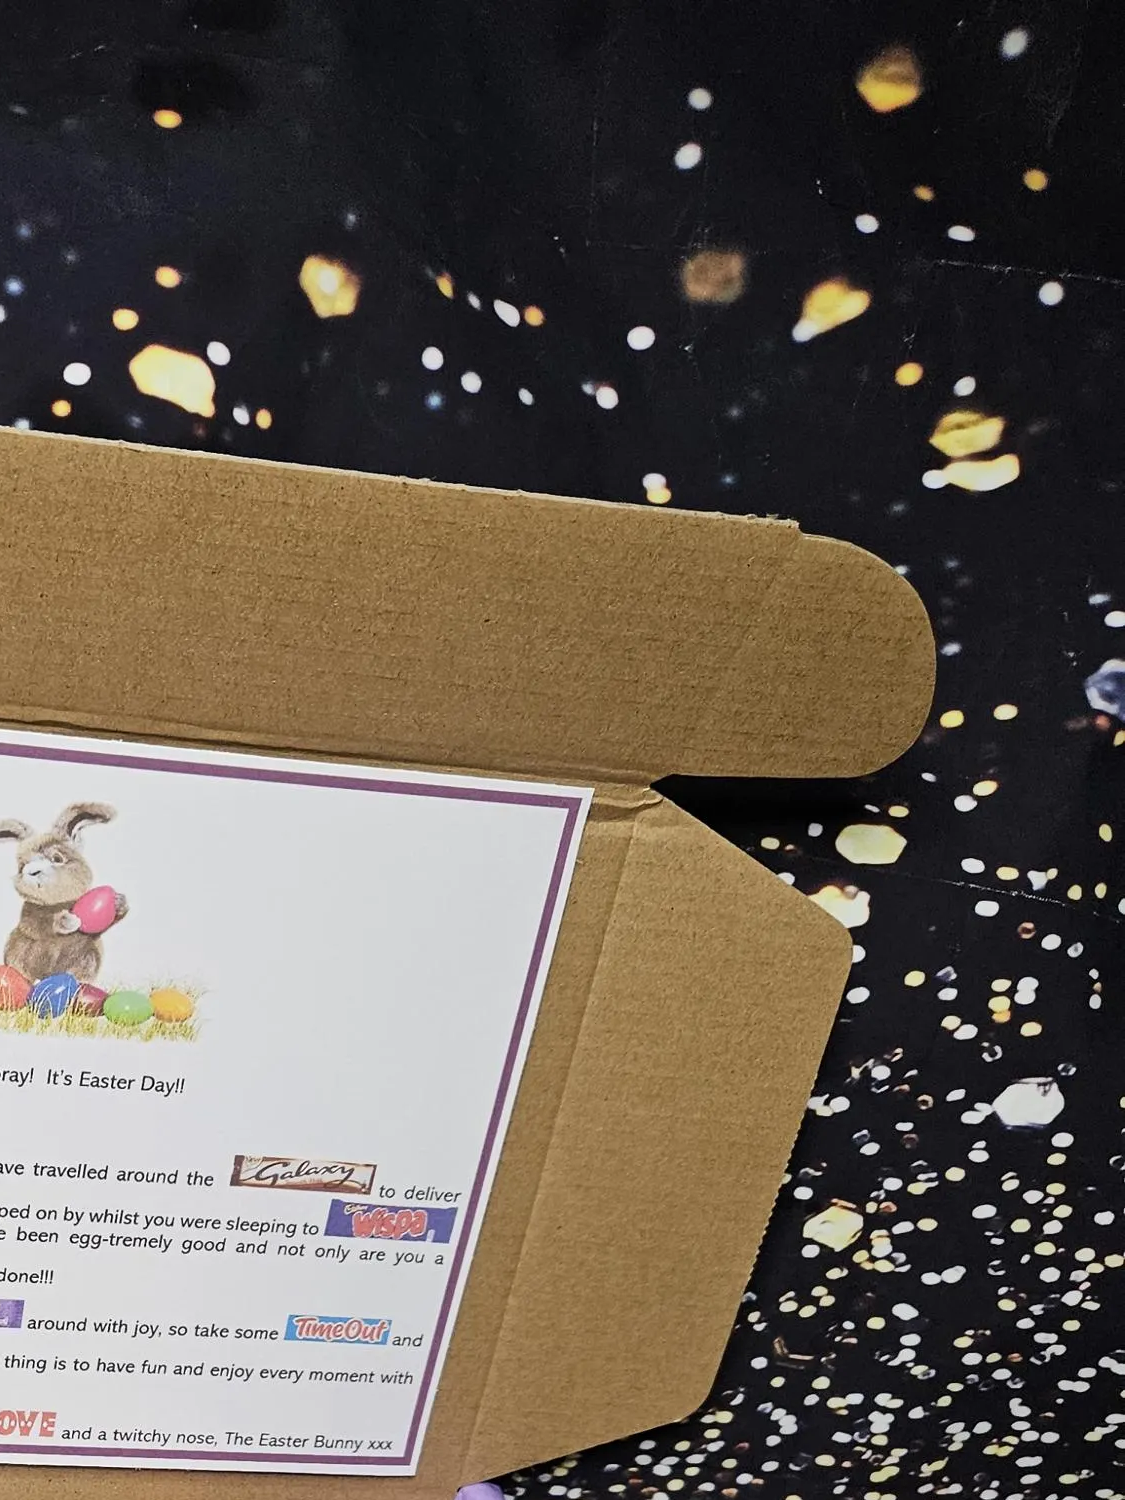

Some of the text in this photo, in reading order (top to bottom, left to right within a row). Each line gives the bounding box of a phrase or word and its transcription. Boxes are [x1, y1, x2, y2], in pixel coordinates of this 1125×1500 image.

[79, 1071, 136, 1090] Easter
[141, 1076, 185, 1097] Day!!
[33, 1163, 108, 1180] travelled
[117, 1170, 178, 1184] around
[187, 1171, 214, 1186] the
[254, 1160, 355, 1187] Galaxy
[380, 1185, 395, 1198] to
[404, 1186, 462, 1202] deliver
[36, 1209, 57, 1220] on
[64, 1206, 84, 1226] by
[89, 1209, 140, 1225] whilst
[143, 1215, 175, 1230] you
[181, 1217, 221, 1229] were
[226, 1216, 297, 1238] sleeping
[303, 1222, 319, 1235] to
[17, 1226, 58, 1243] been
[69, 1233, 173, 1253] egg-tremely
[181, 1238, 226, 1254] good
[236, 1240, 268, 1254] and
[278, 1244, 306, 1256] not
[315, 1245, 350, 1263] only
[359, 1250, 385, 1261] are
[393, 1252, 425, 1266] you
[435, 1255, 443, 1265] a
[27, 1318, 87, 1331] around
[94, 1319, 128, 1333] with
[131, 1320, 161, 1339] joy,
[168, 1326, 187, 1336] so
[195, 1324, 229, 1338] take
[234, 1328, 278, 1340] some
[392, 1334, 424, 1347] and
[5, 1354, 47, 1373] thing
[54, 1356, 66, 1370] is
[74, 1359, 90, 1371] to
[97, 1358, 135, 1373] have
[142, 1360, 167, 1374] fun
[173, 1363, 204, 1376] and
[210, 1364, 254, 1382] enjoy
[260, 1369, 304, 1384] every
[309, 1371, 375, 1383] moment
[381, 1371, 413, 1384] with
[61, 1427, 92, 1440] and
[98, 1431, 107, 1440] a
[113, 1429, 171, 1447] twitchy
[176, 1434, 217, 1446] nose,
[225, 1432, 253, 1446] The
[259, 1433, 309, 1447] Easter
[314, 1435, 363, 1453] Bunny
[367, 1441, 392, 1450] xxx
